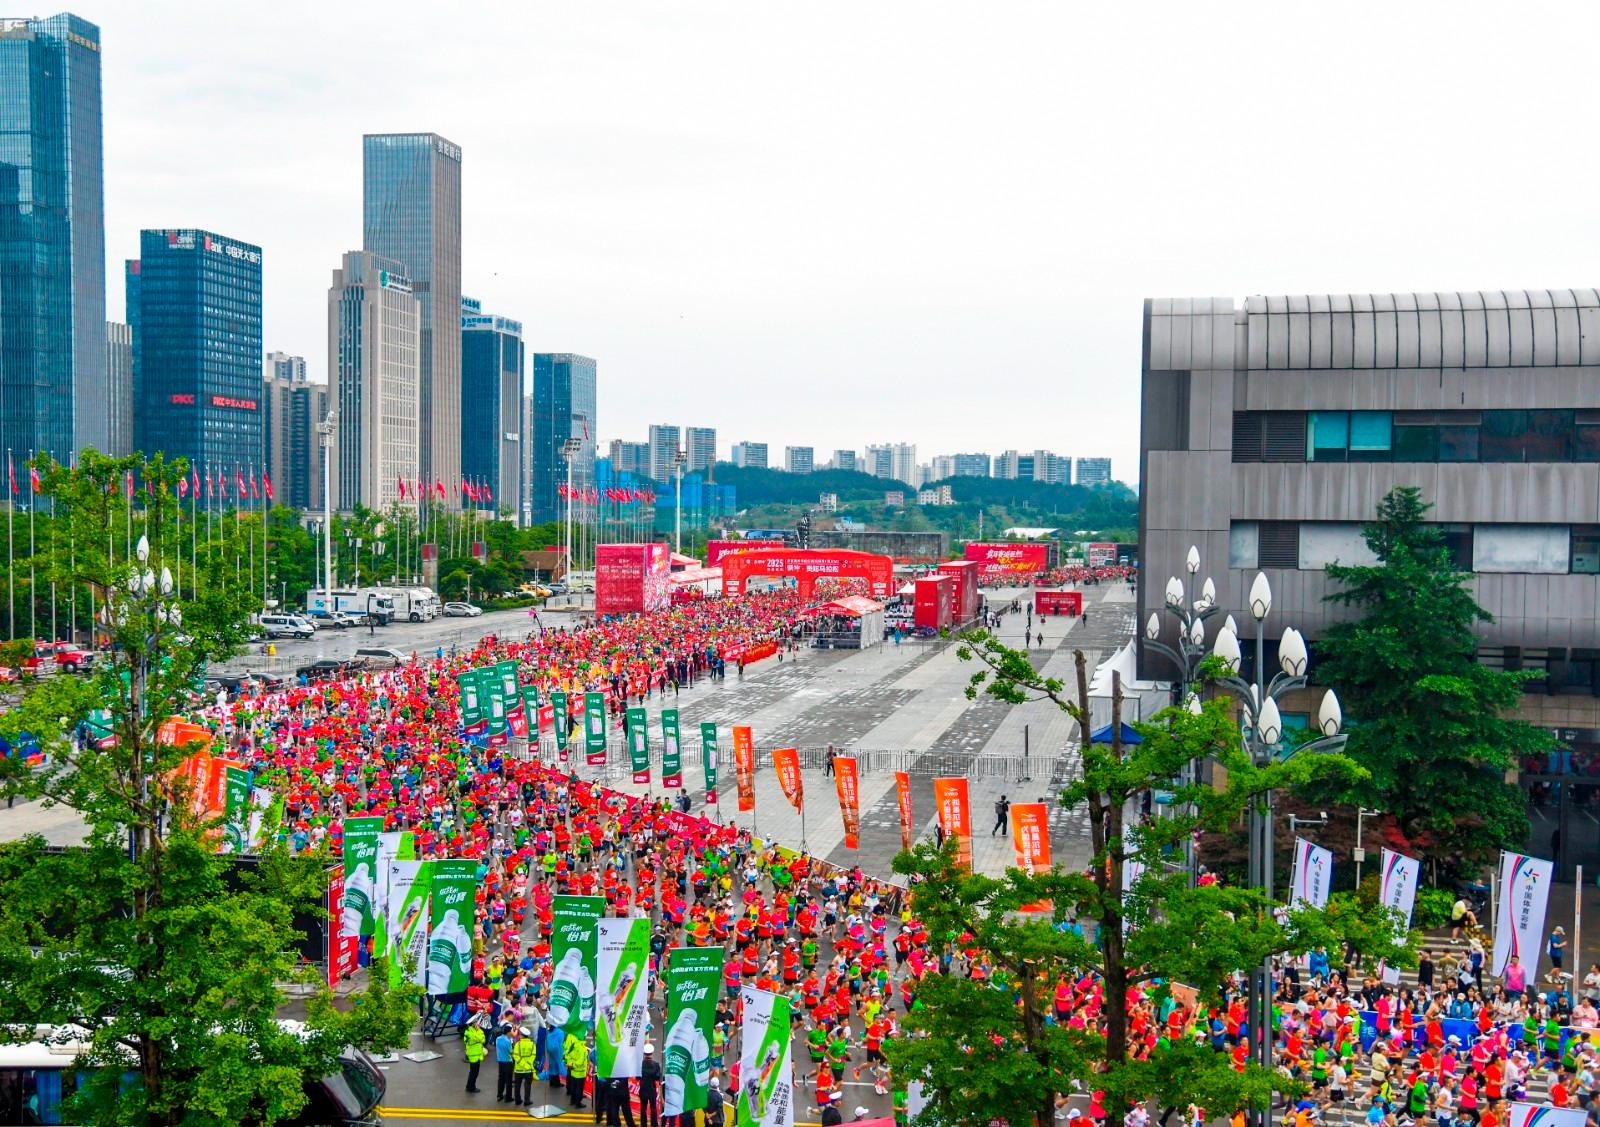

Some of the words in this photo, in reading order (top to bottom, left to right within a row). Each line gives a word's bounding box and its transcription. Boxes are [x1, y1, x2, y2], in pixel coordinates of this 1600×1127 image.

[225, 245, 260, 265] 中国光大银行
[766, 559, 784, 569] 2025
[1520, 884, 1534, 930] 中国体育彩票
